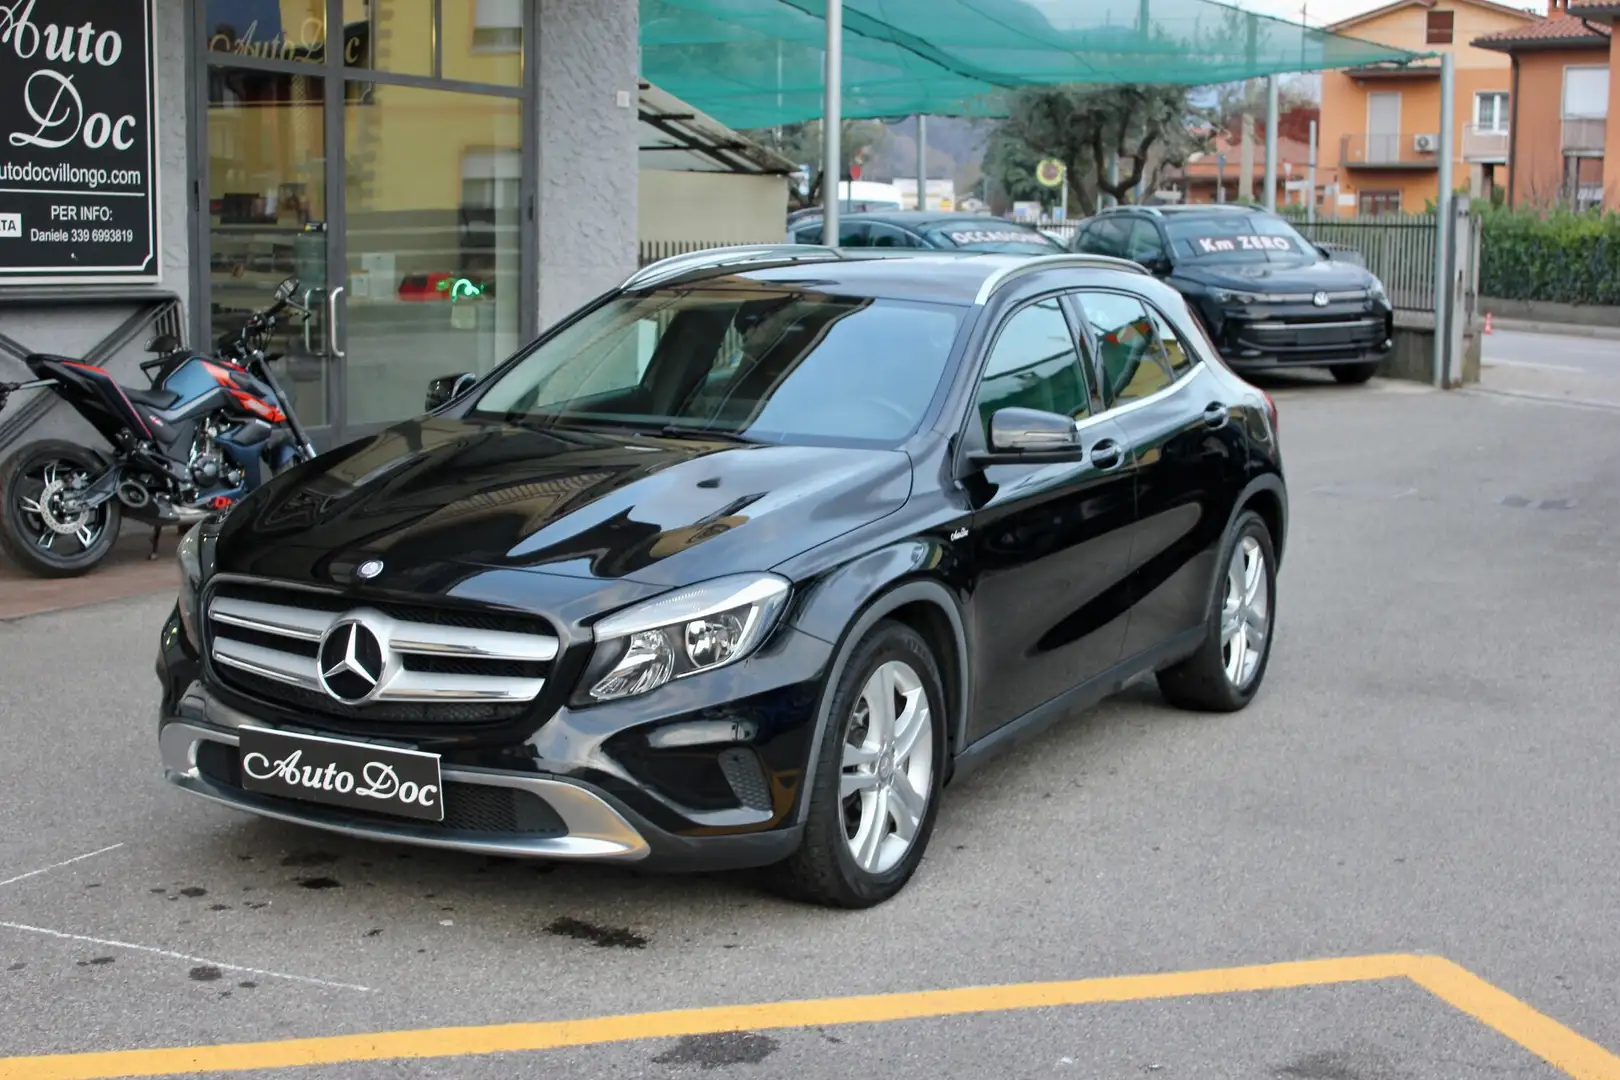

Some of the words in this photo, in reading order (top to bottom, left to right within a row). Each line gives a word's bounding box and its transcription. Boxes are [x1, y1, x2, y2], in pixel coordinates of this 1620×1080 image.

[9, 69, 136, 150] Doc
[51, 205, 77, 221] PER
[80, 206, 113, 221] INFO:
[0, 219, 17, 232] TA
[30, 228, 69, 242] Daniele
[71, 229, 90, 242] 339
[91, 229, 133, 242] 6993819
[1199, 238, 1234, 252] Km
[1236, 236, 1290, 250] ZERO
[243, 749, 354, 793] Auto
[355, 761, 438, 806] Doc
